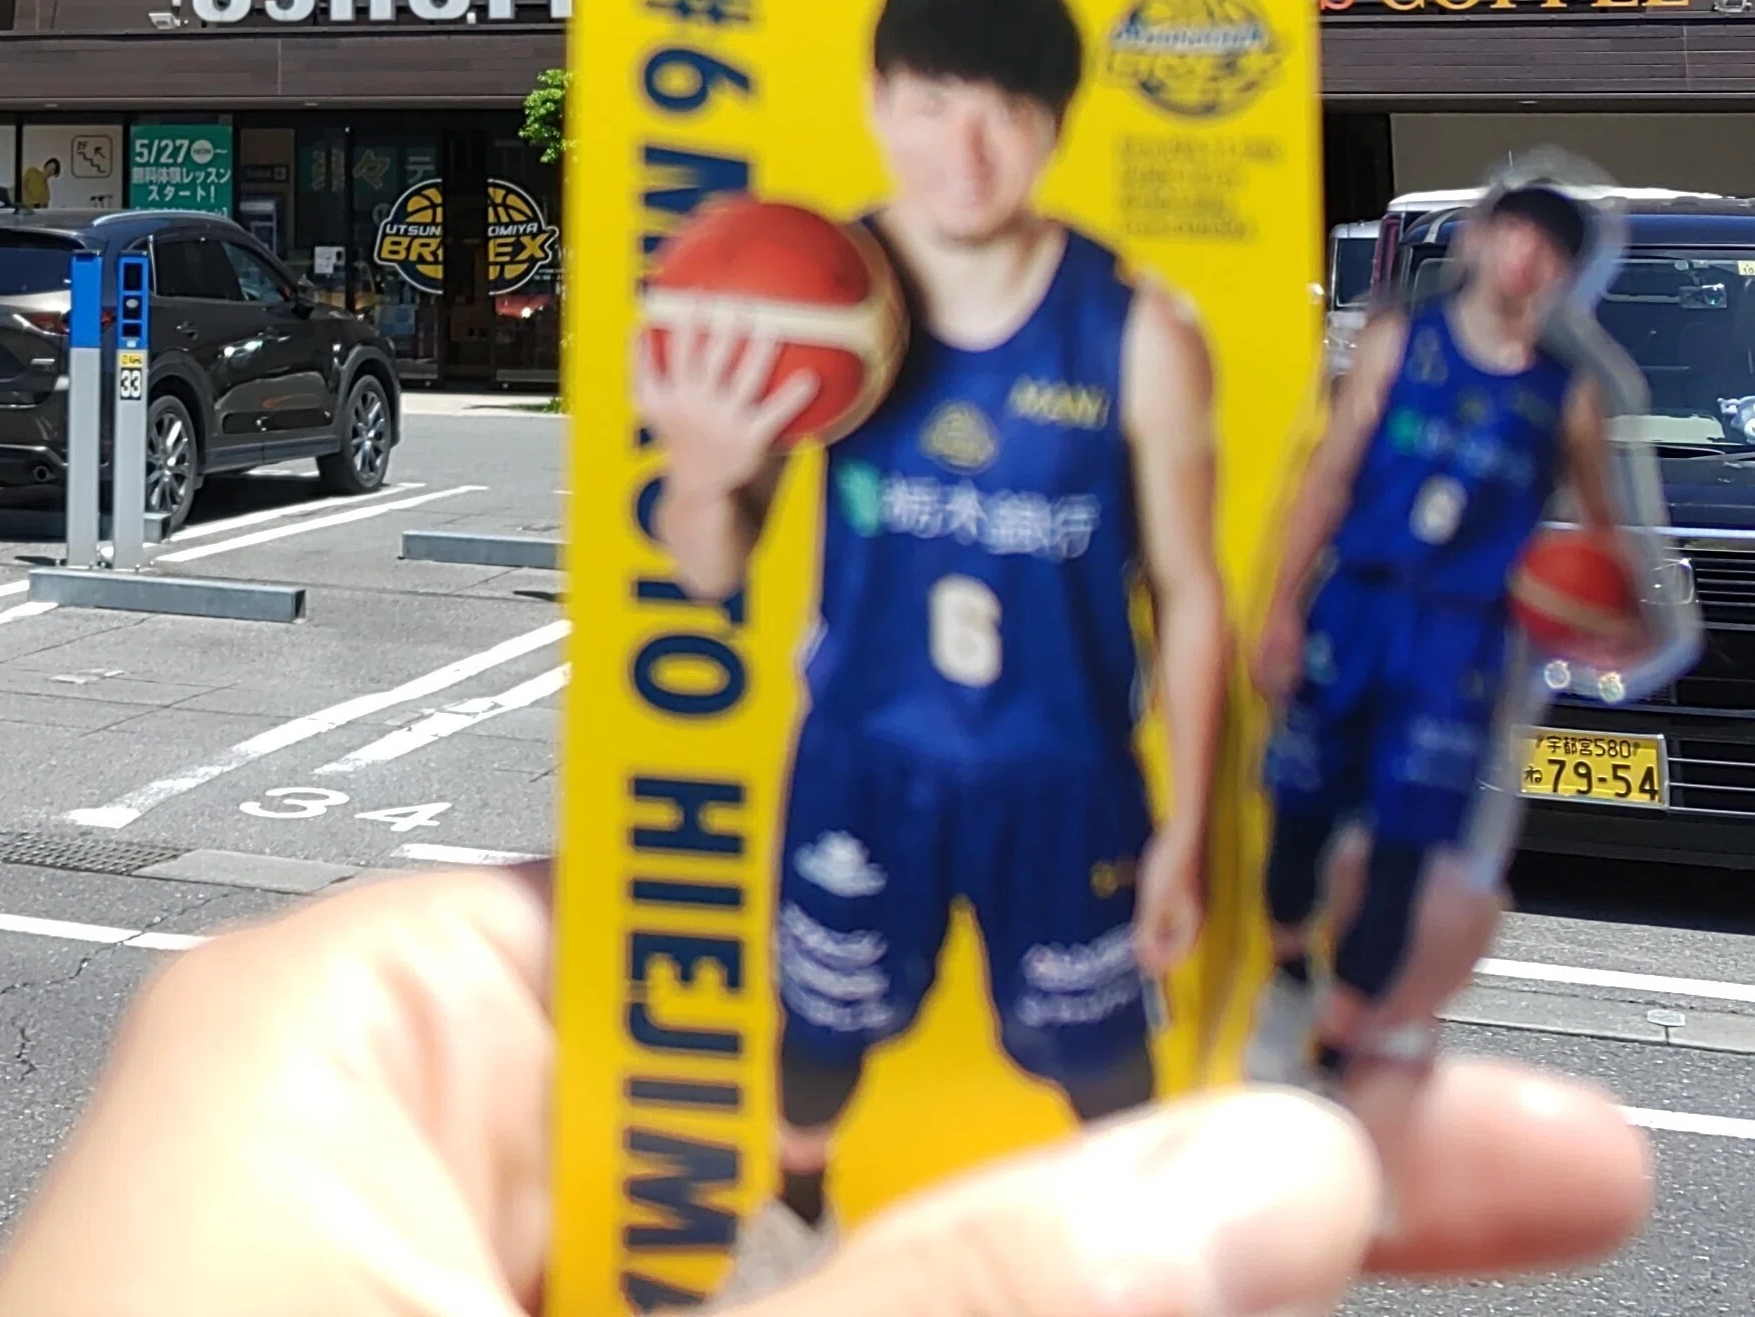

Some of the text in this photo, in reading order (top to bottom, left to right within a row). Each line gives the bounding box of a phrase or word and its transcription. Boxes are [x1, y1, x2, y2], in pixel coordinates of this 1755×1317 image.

[134, 139, 189, 164] 5/27
[121, 370, 141, 397] 33
[1547, 736, 1632, 758] 宇都宮580
[1547, 758, 1659, 801] 79-54
[239, 787, 453, 833] 34
